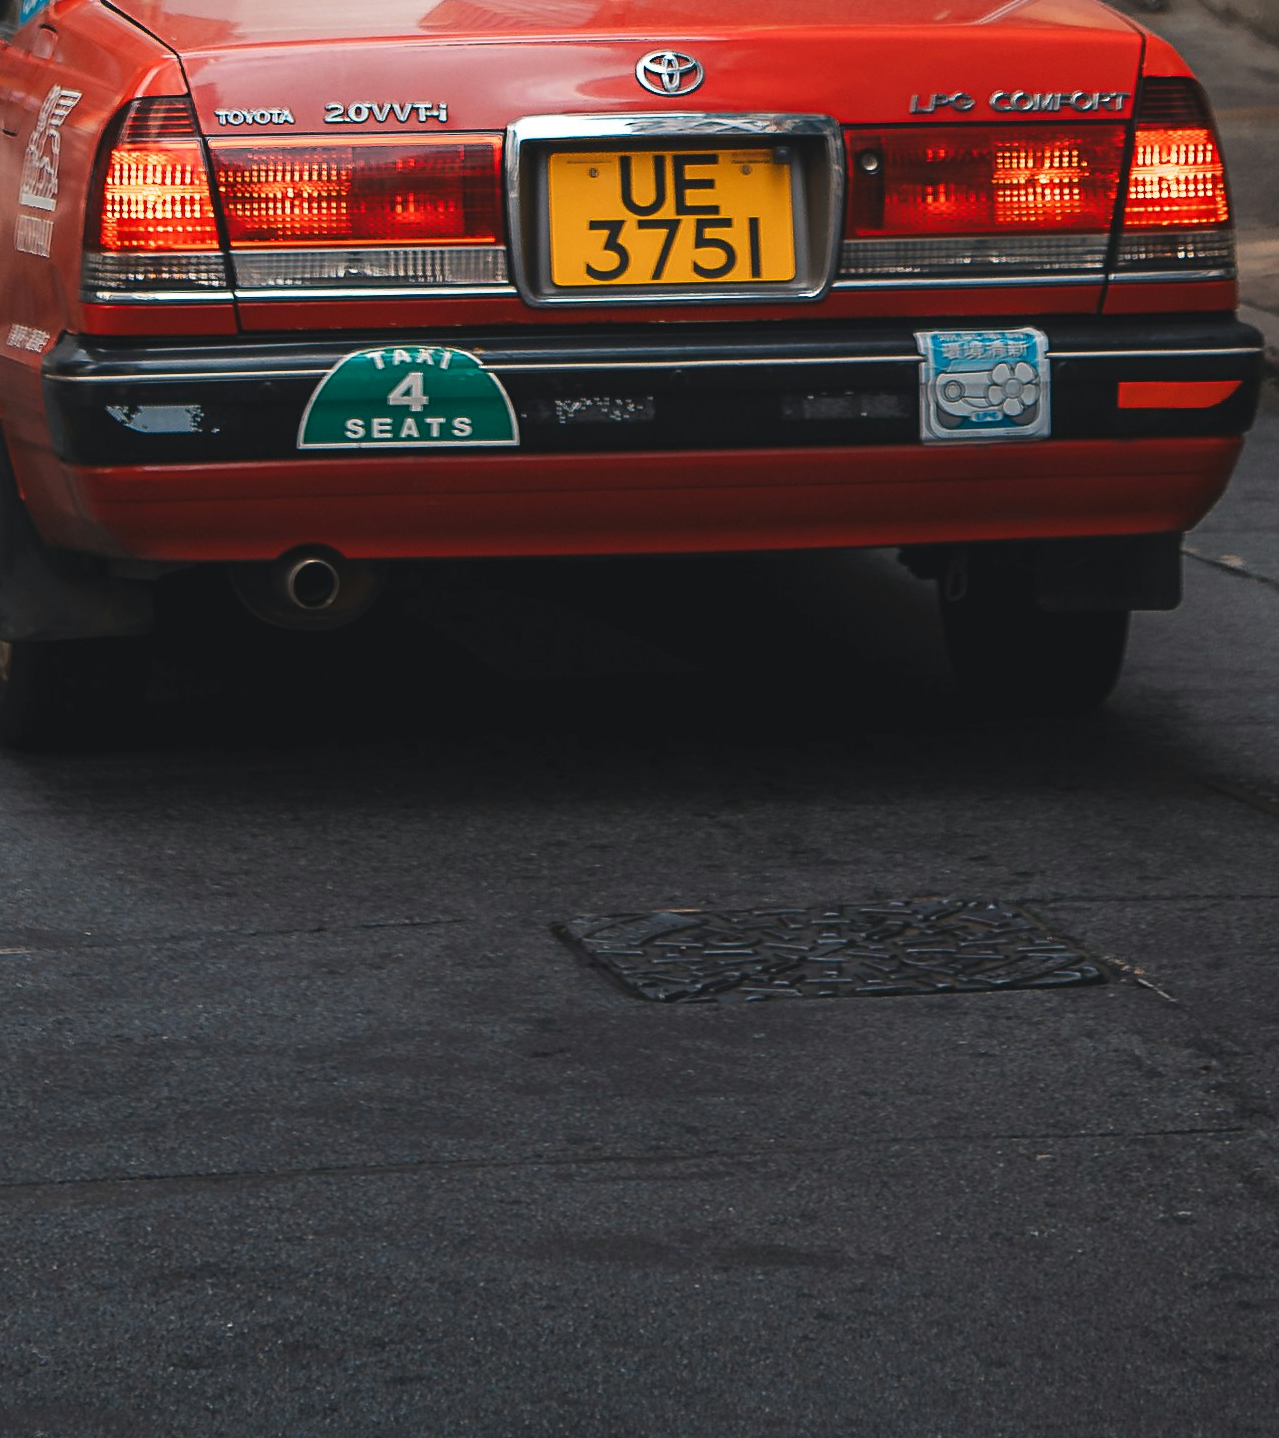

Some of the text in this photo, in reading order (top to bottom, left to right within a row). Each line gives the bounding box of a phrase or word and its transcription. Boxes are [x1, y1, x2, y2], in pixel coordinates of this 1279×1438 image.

[909, 89, 1131, 115] LPG COMFORT
[214, 107, 295, 126] TOYOTA
[619, 153, 721, 217] UE
[585, 217, 762, 281] 3751
[366, 347, 453, 371] TAXI
[387, 372, 430, 413] 4
[345, 417, 475, 439] SEATS
